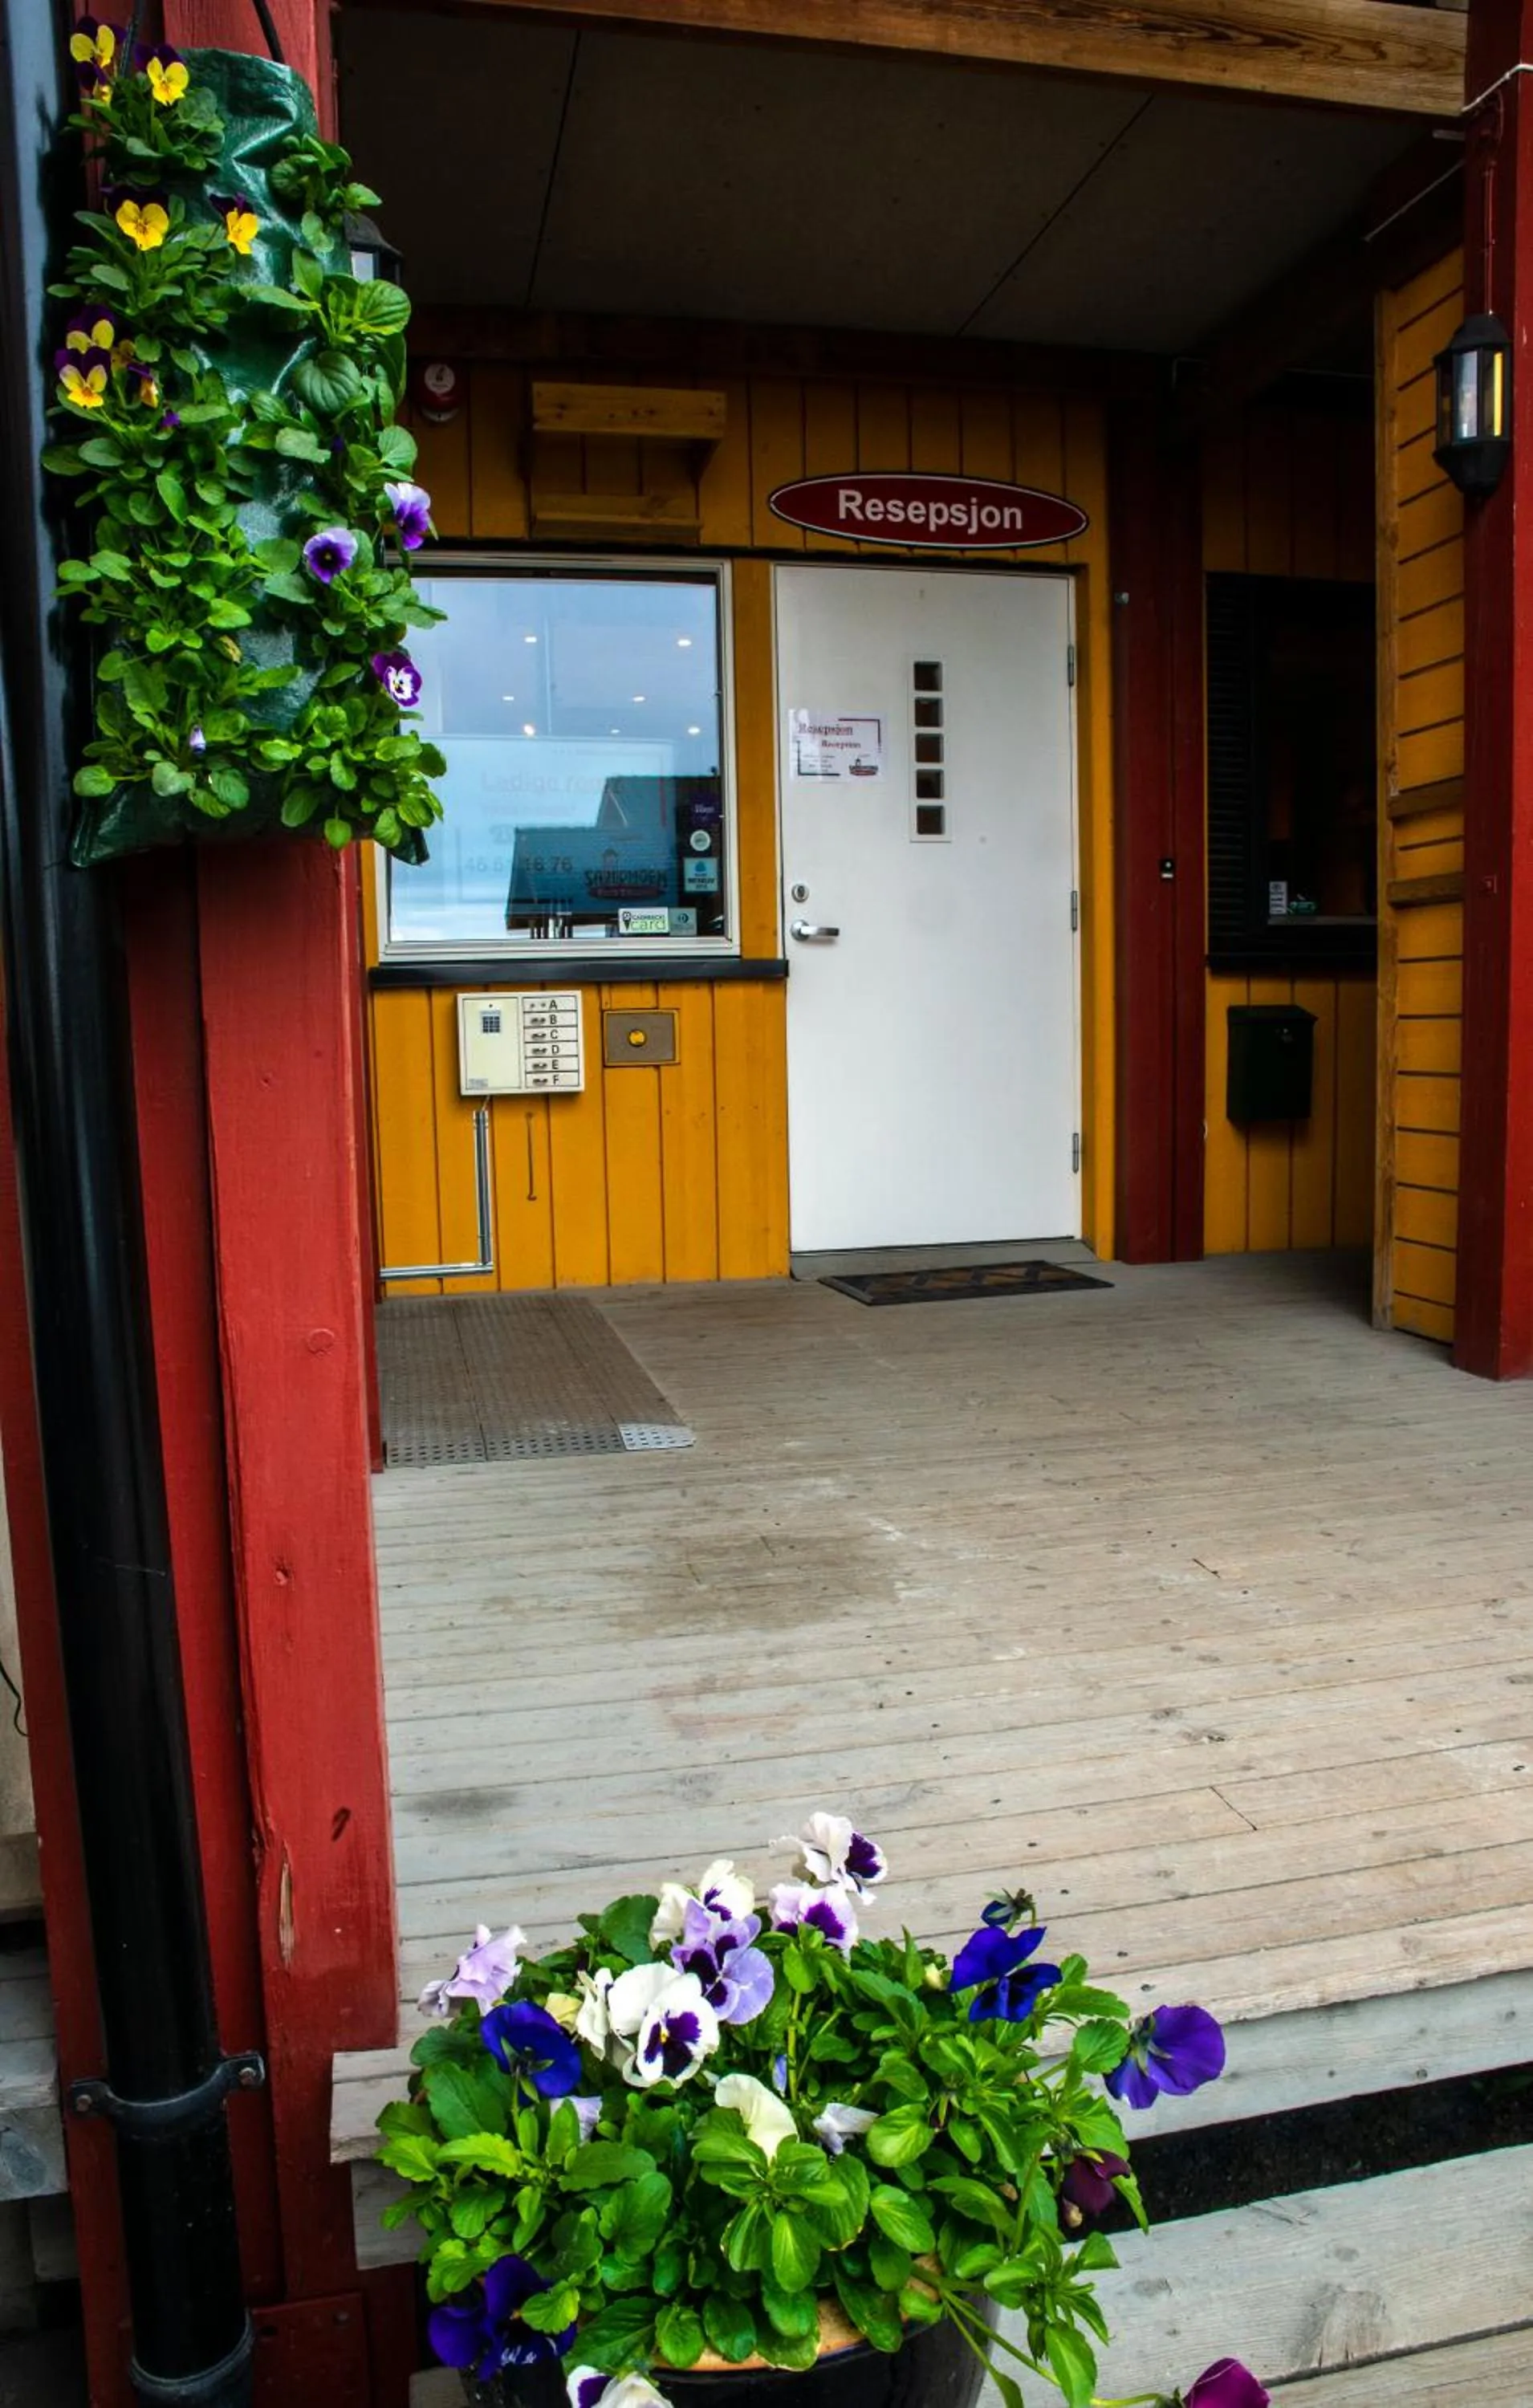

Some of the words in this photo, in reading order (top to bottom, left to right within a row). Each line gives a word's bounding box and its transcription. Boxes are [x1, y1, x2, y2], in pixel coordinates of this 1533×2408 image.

[838, 489, 1023, 535] Resepsjon
[549, 999, 558, 1009] A
[549, 1014, 557, 1024] B
[550, 1029, 558, 1039] C
[551, 1044, 559, 1054] D
[551, 1059, 559, 1069] E
[552, 1075, 559, 1084] F
